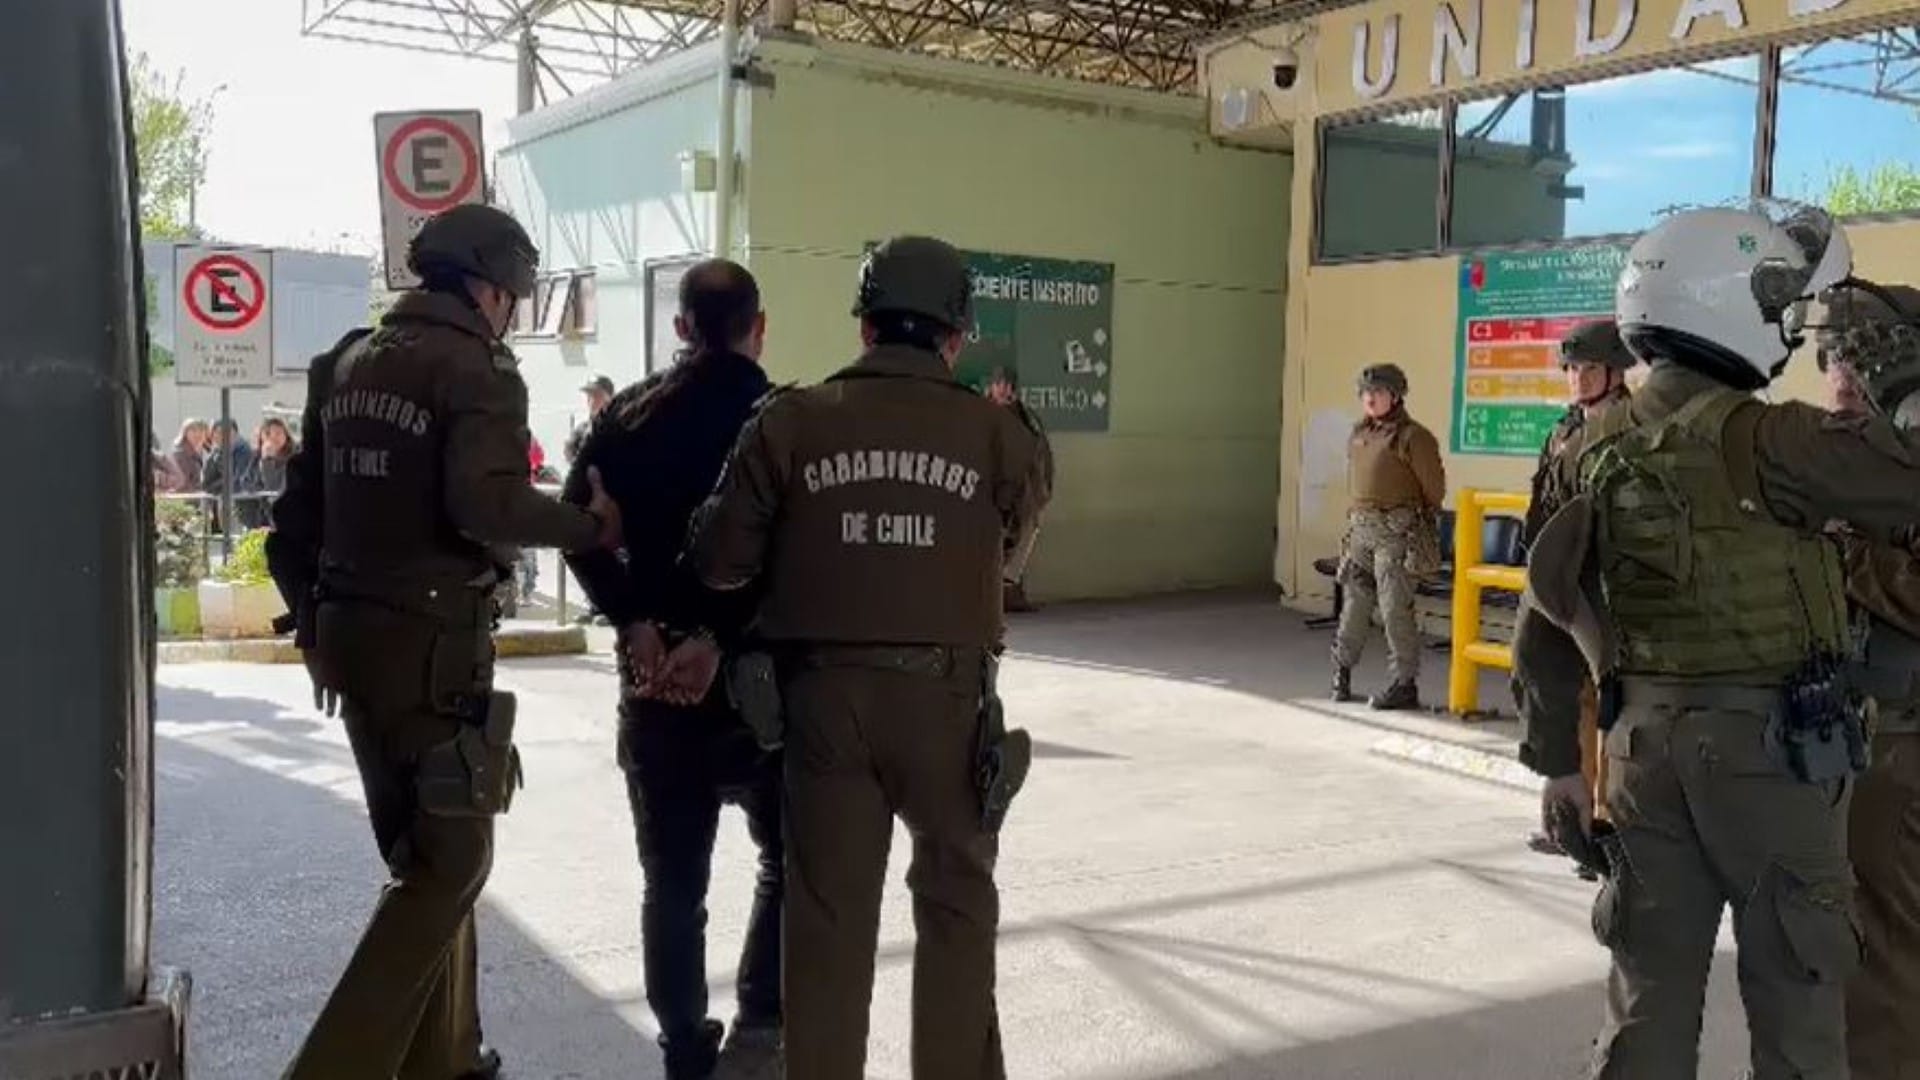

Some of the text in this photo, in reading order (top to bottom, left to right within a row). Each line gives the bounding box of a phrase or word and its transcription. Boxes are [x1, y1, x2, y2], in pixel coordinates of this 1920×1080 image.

[412, 136, 450, 192] E
[1472, 323, 1492, 337] C1
[804, 449, 980, 500] CARABINEROS
[842, 511, 935, 546] DE CHILE
